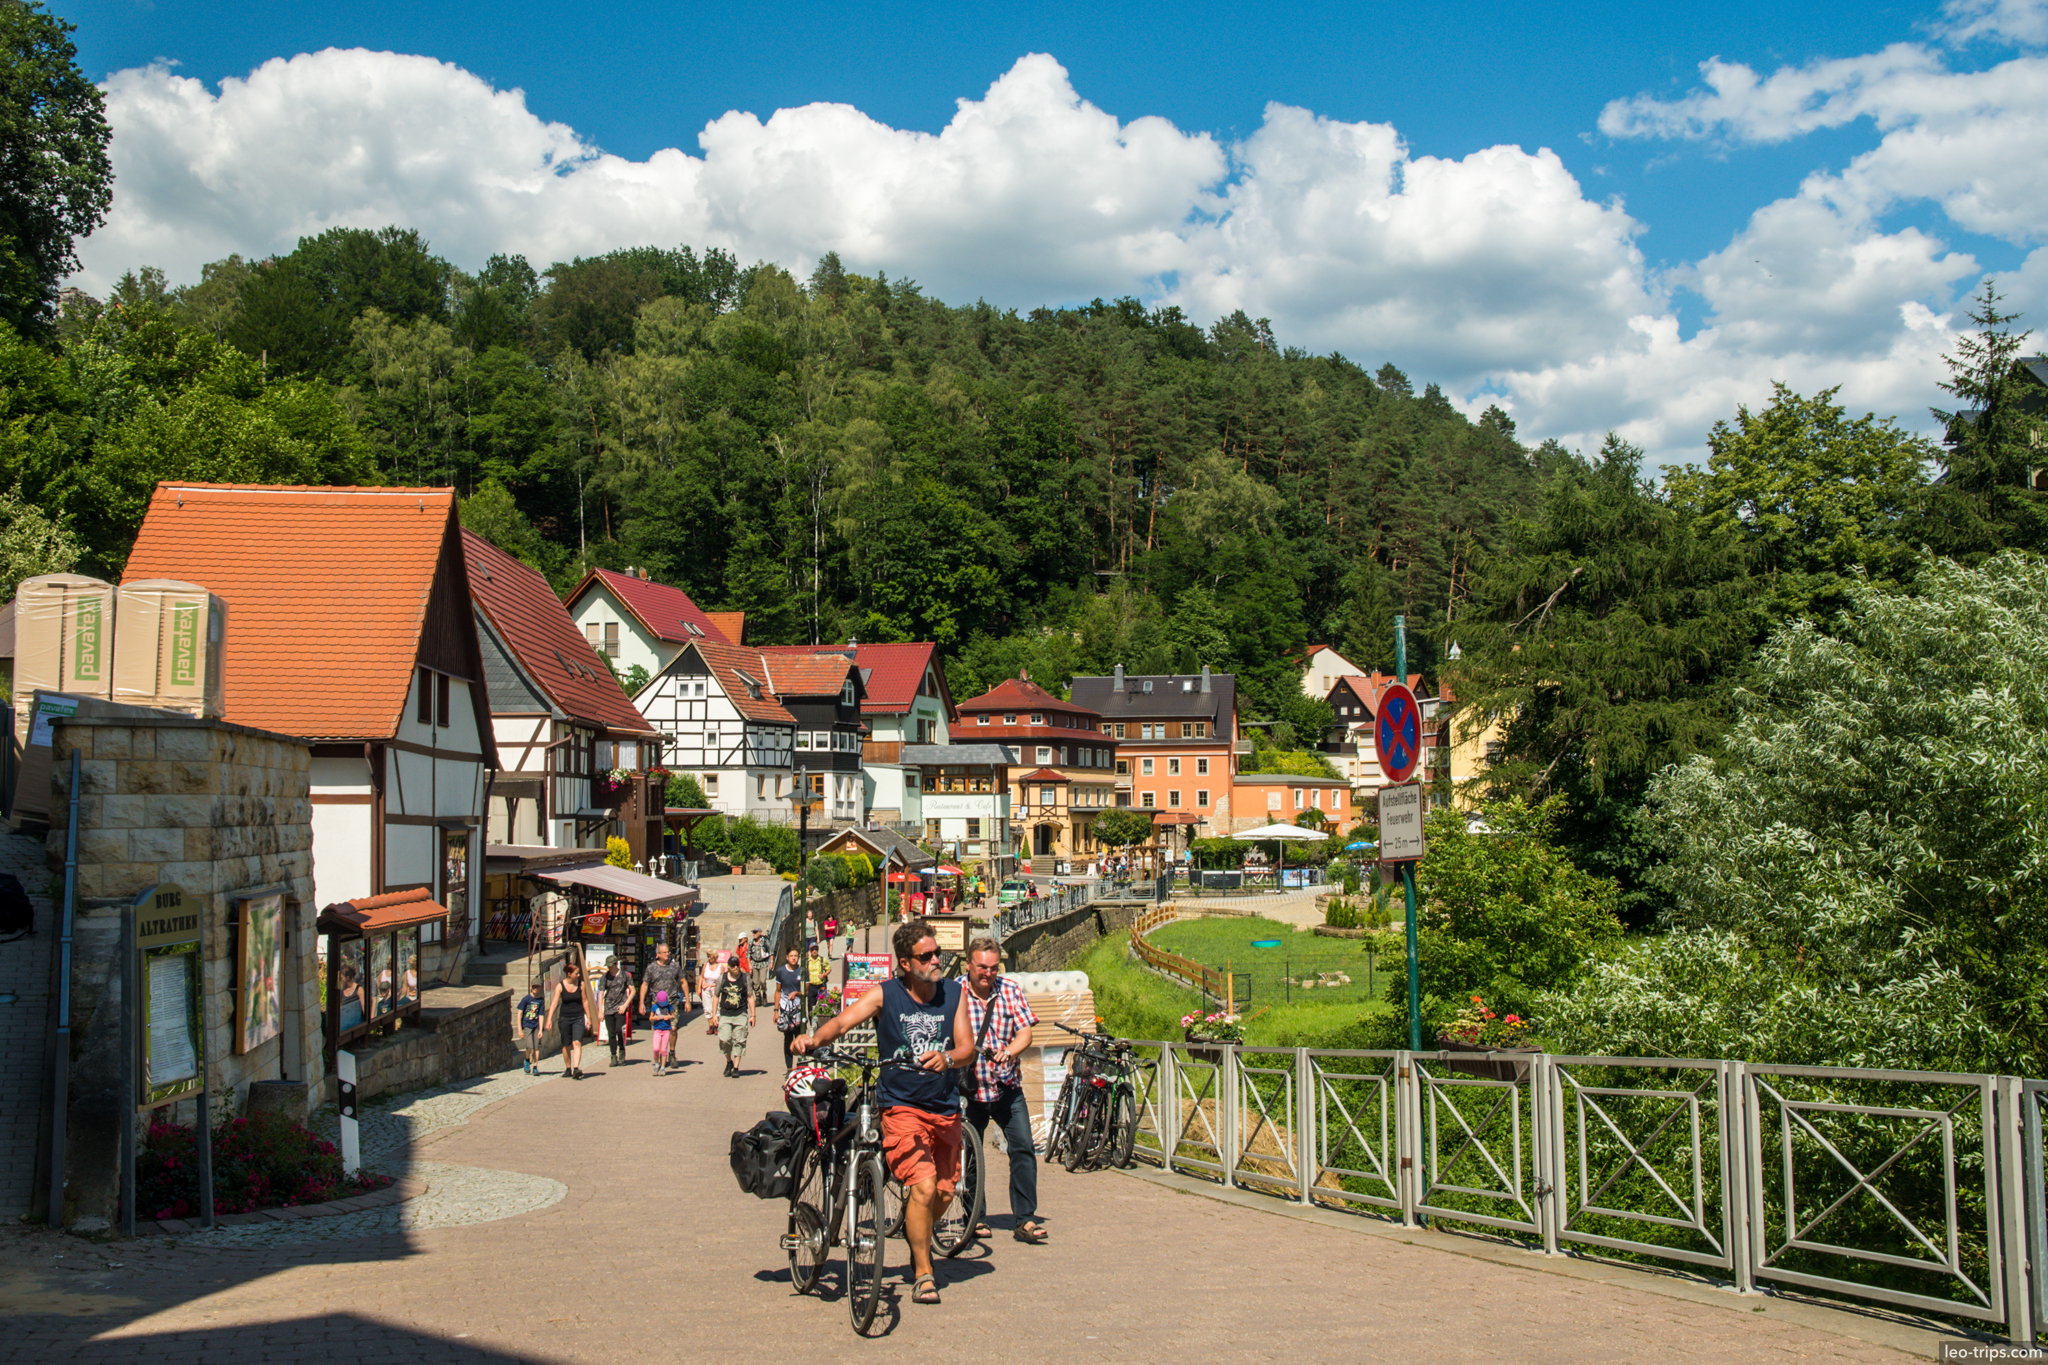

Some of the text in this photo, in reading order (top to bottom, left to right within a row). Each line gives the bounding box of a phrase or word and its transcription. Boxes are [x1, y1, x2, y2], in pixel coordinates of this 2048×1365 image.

[76, 603, 100, 676] pavatex
[173, 607, 195, 681] pavatex
[40, 703, 74, 714] pavatex
[1382, 791, 1417, 808] Aufstellfläche
[1387, 810, 1413, 826] Feuerwehr
[156, 891, 182, 909] BURG
[139, 914, 198, 937] ALTRATHEN
[846, 954, 890, 963] Rosengarten
